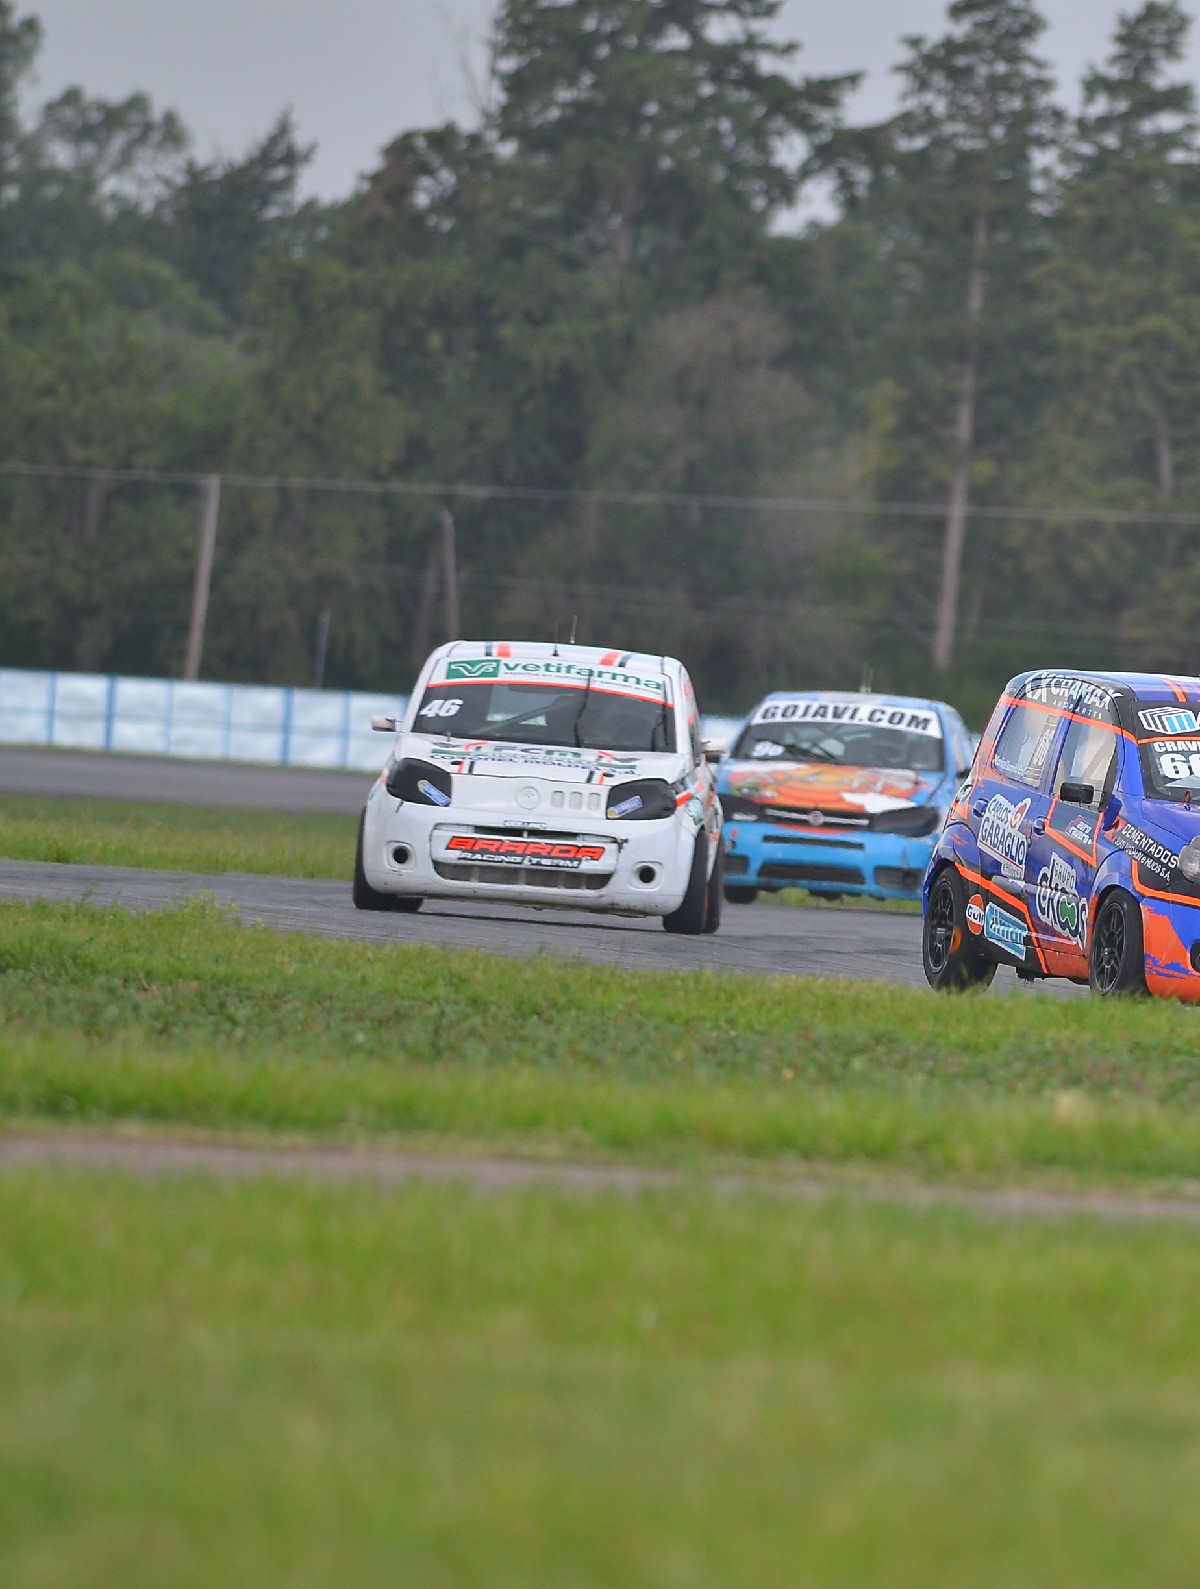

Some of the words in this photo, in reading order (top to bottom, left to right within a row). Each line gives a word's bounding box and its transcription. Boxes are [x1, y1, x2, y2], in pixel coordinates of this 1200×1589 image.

[503, 662, 664, 691] vetifarma
[419, 699, 464, 718] 46
[761, 703, 932, 731] GOJAVI.COM
[981, 817, 1026, 866] GABAGLIO
[1122, 823, 1179, 868] CEMENTADOS
[460, 851, 523, 865] RACING
[530, 857, 579, 868] TEAM
[1054, 862, 1075, 890] GRUPO
